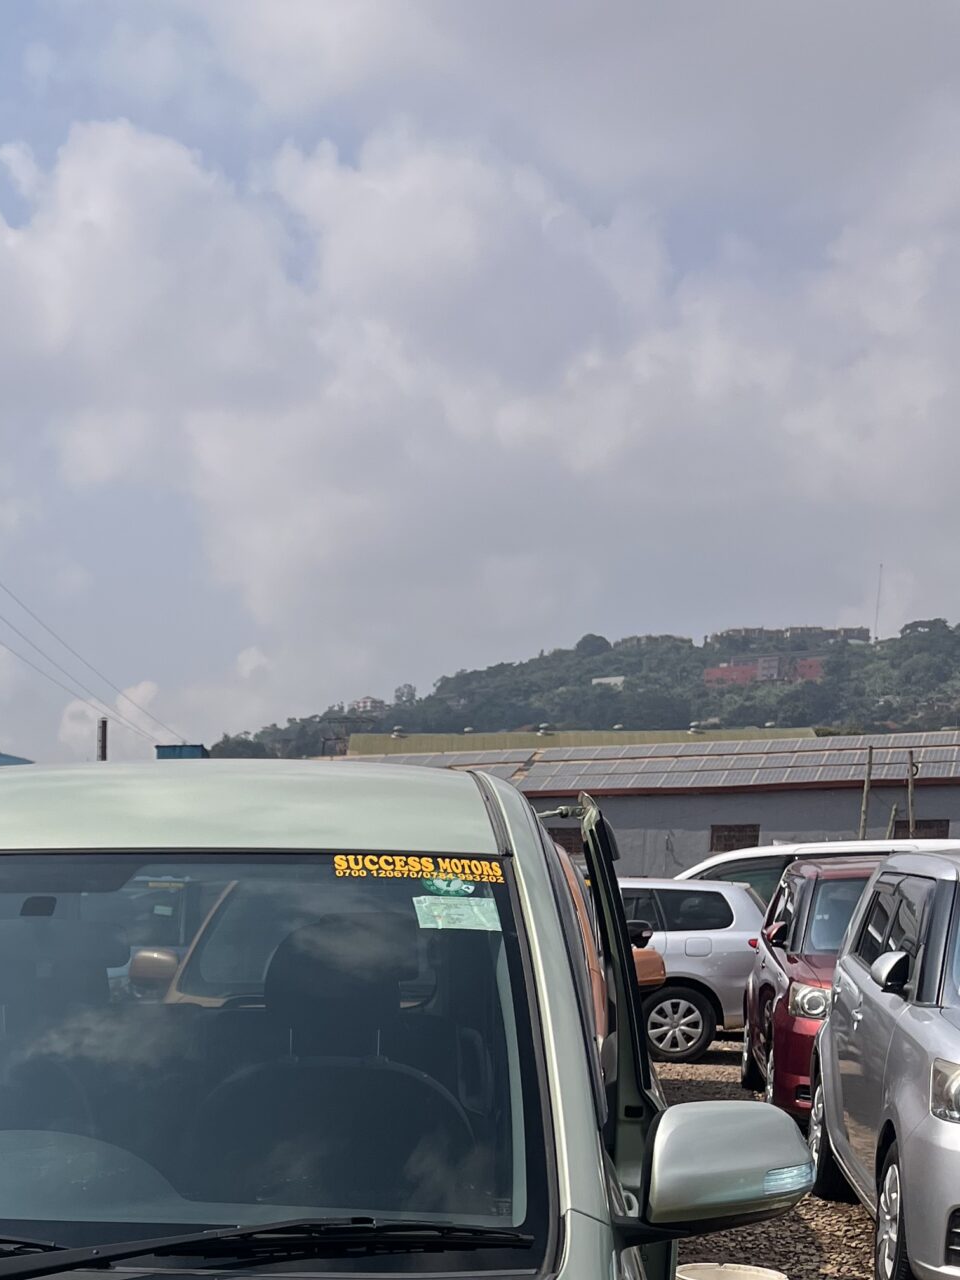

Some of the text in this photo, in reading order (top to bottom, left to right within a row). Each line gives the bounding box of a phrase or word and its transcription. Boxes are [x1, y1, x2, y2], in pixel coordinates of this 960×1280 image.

[333, 855, 502, 876] SUCCESS MOTORS
[335, 869, 367, 877] 0700
